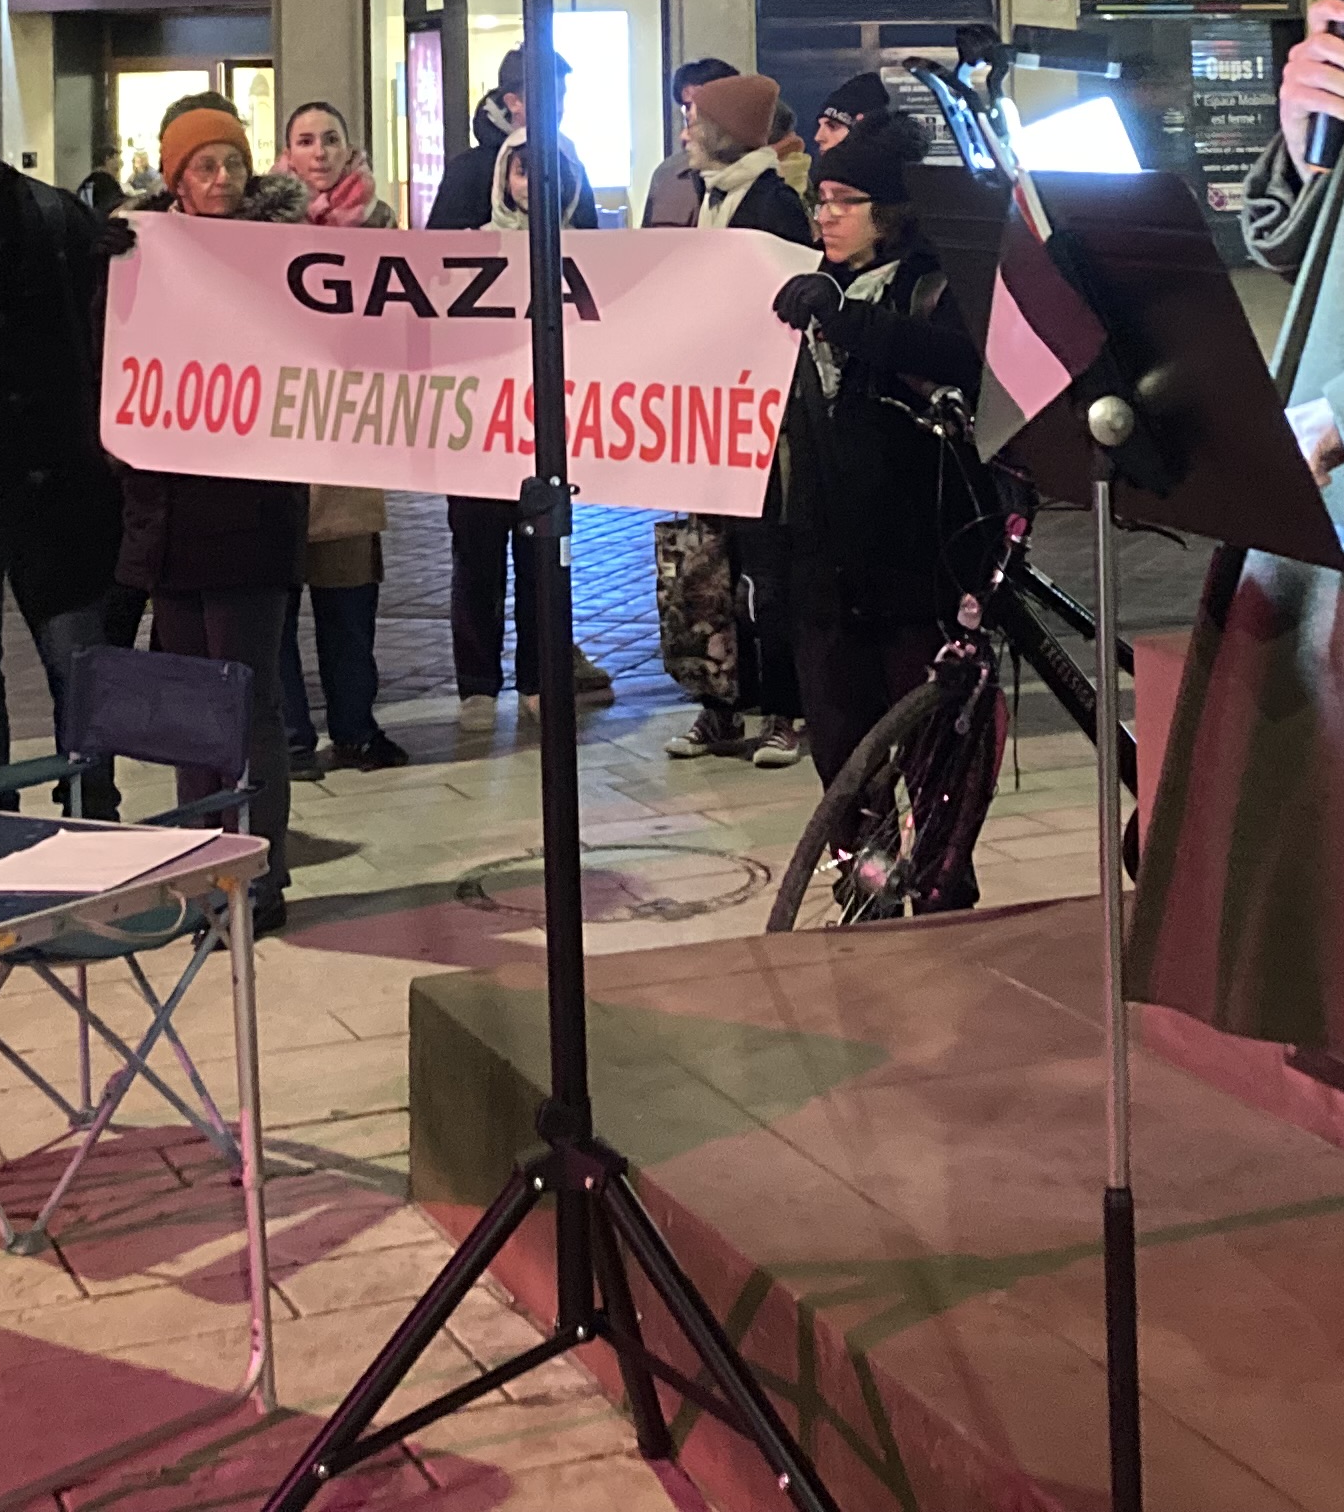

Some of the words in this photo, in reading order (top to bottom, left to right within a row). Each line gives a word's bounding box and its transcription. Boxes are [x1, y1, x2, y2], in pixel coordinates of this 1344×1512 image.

[1206, 56, 1253, 81] Oups
[115, 356, 262, 437] 20.000
[269, 365, 480, 451] ENFANTS
